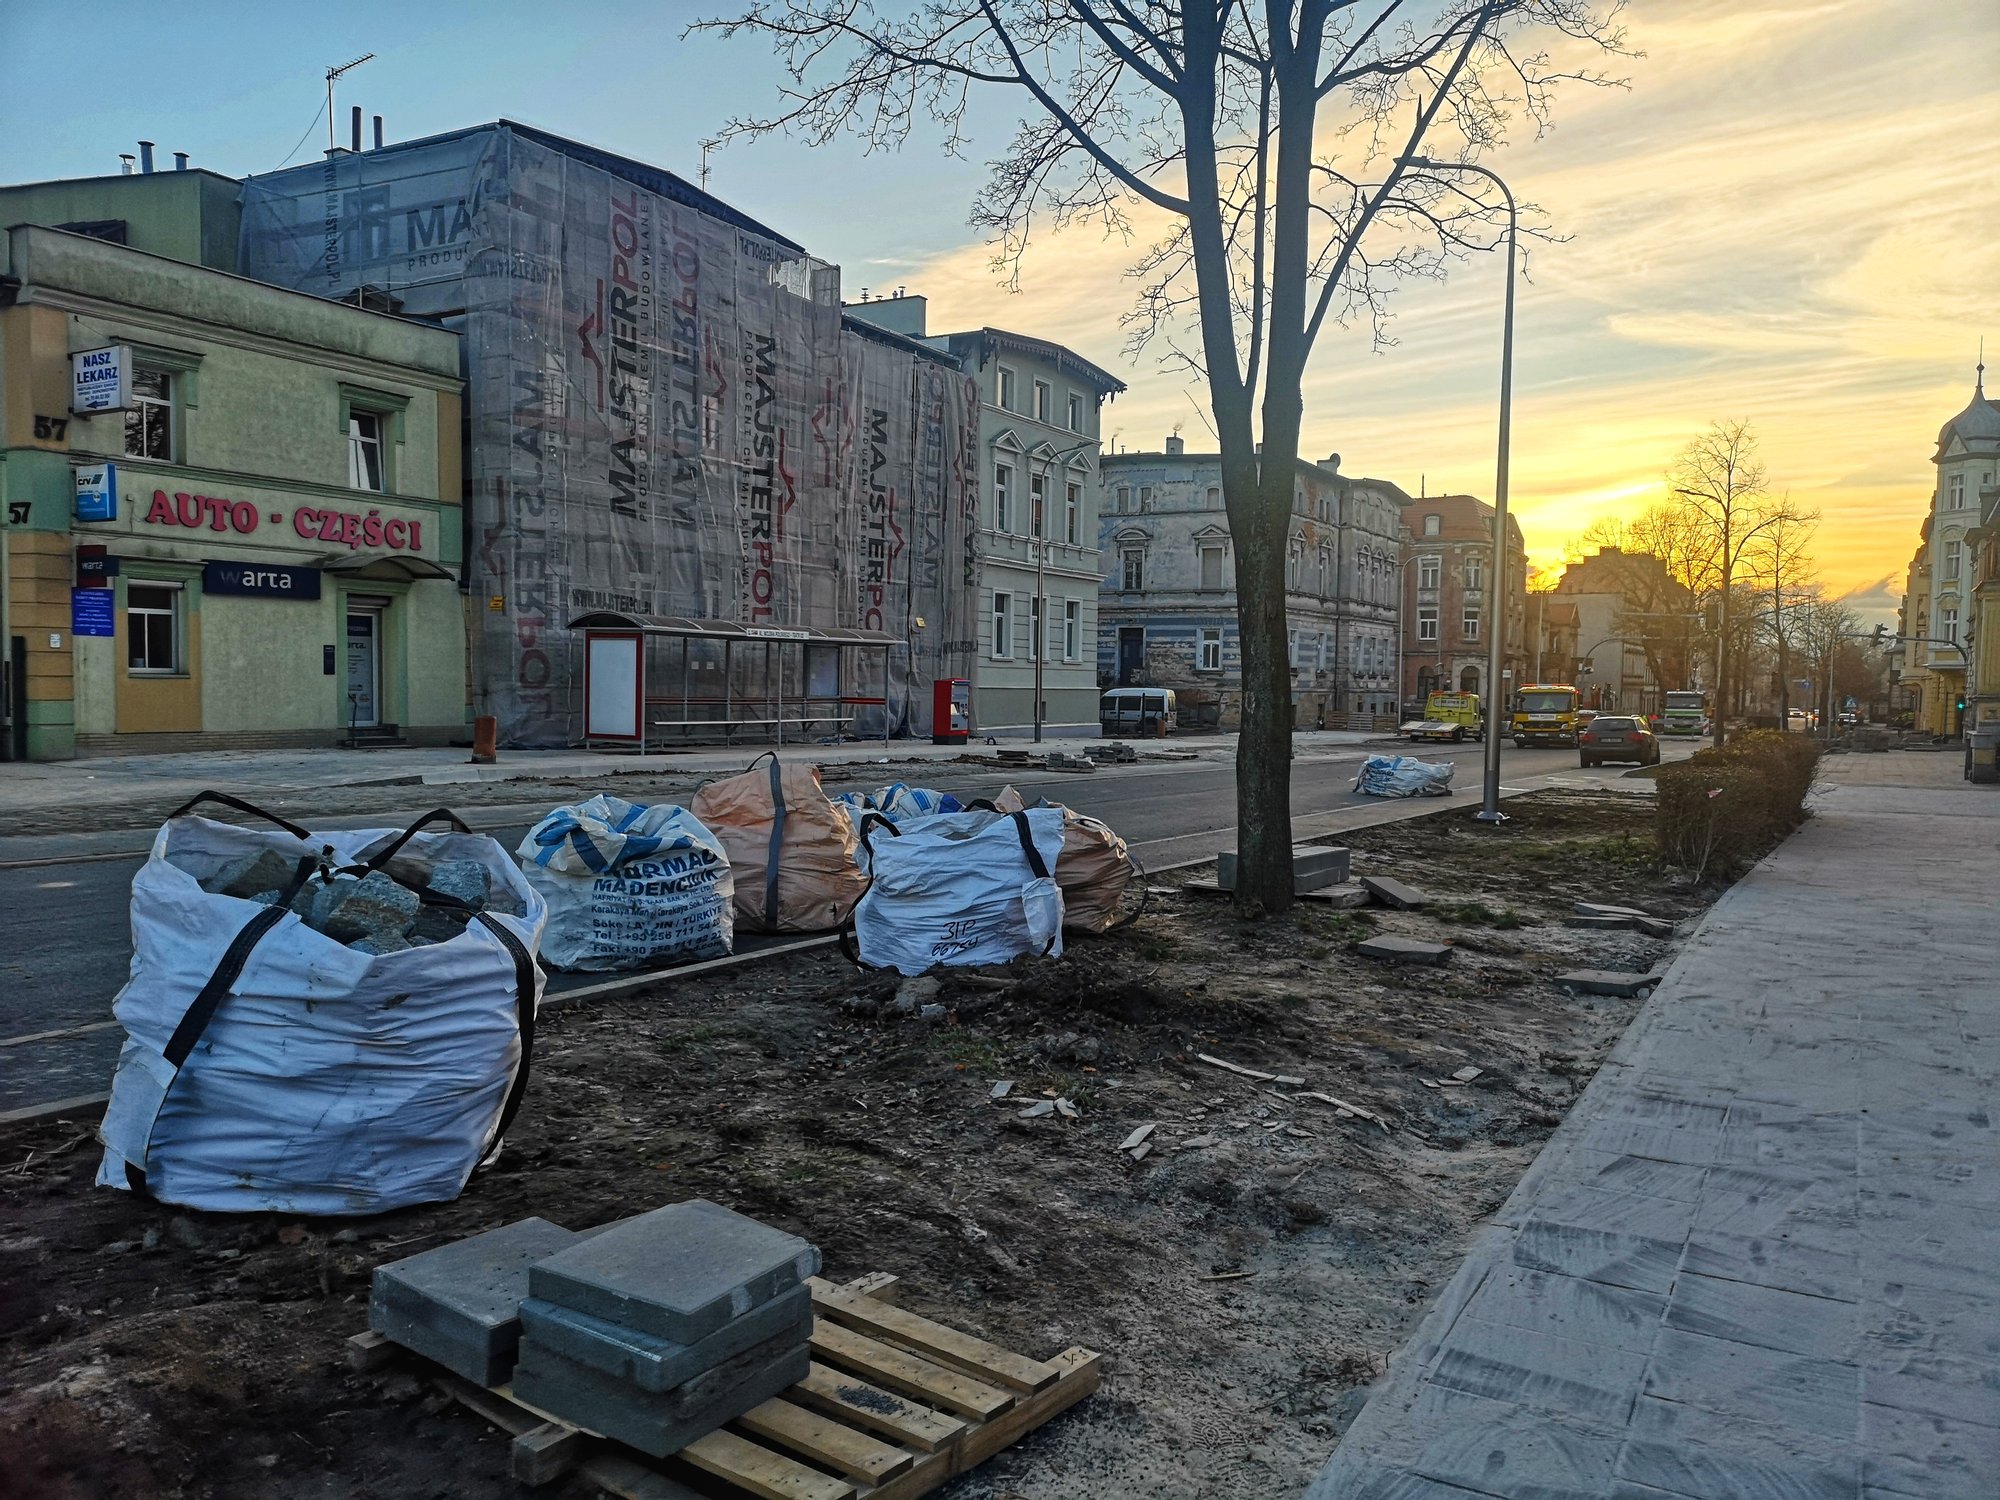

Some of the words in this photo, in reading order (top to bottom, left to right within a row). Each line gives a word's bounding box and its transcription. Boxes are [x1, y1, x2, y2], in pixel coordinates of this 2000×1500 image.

[83, 352, 111, 368] NASZ
[609, 190, 640, 519] MAJSTERPOL
[77, 367, 118, 384] LEKARZ
[34, 415, 68, 441] 57
[750, 333, 776, 624] MAJSTERPOL
[9, 502, 32, 525] 57
[146, 489, 259, 534] AUTO
[294, 506, 422, 551] CZĘŚCI
[220, 570, 292, 589] warta
